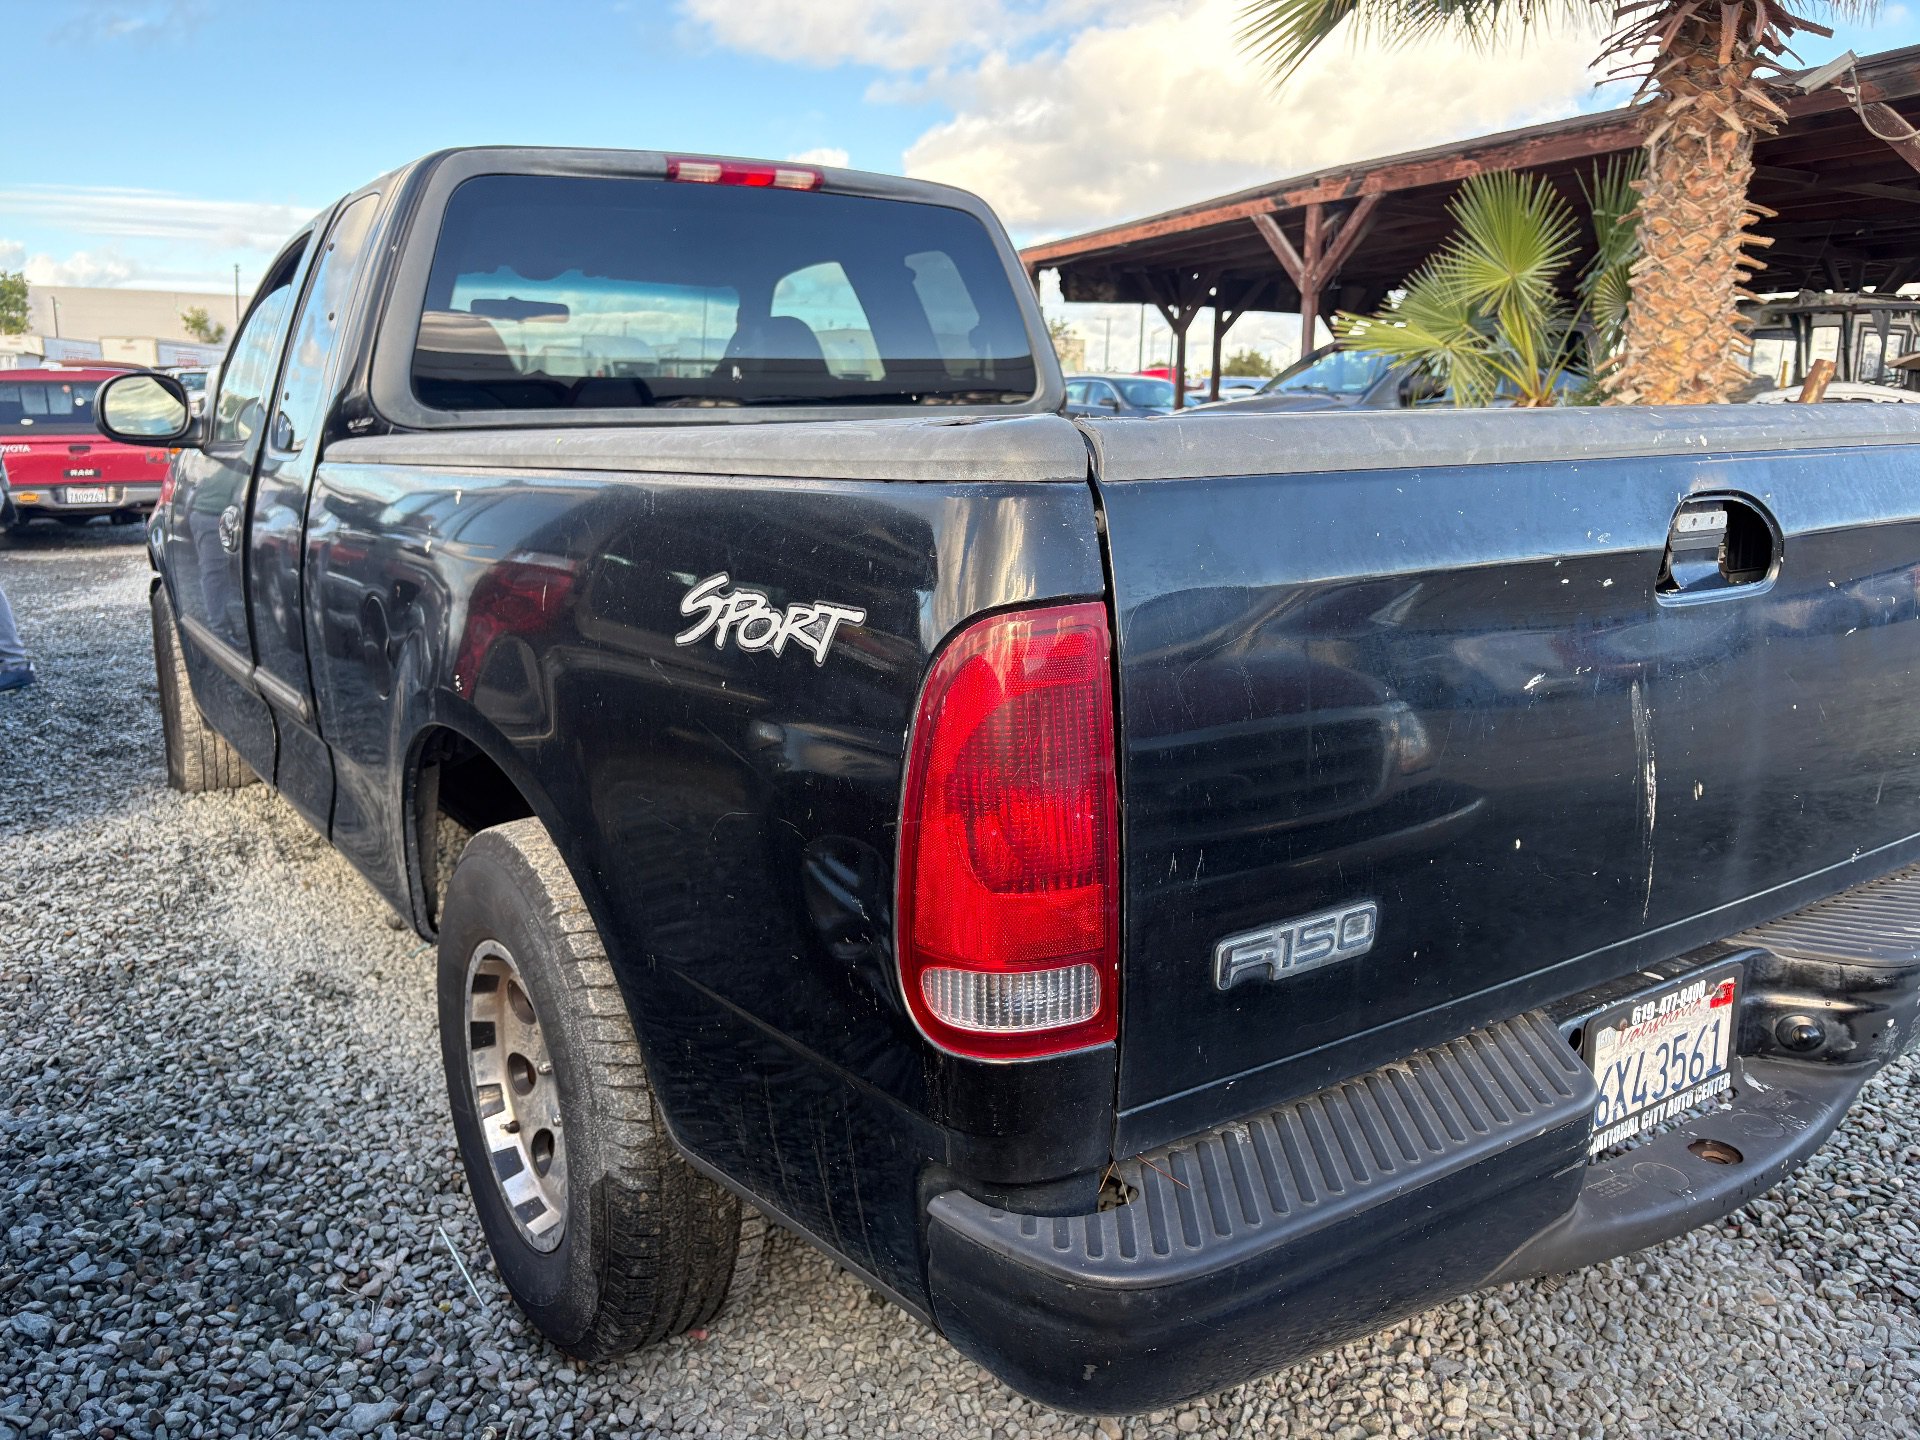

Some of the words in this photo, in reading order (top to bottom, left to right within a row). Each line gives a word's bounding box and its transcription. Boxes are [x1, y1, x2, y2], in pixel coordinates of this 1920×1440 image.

[69, 468, 95, 477] RAM
[675, 572, 867, 666] SPORT
[1631, 979, 1707, 1025] 619-477-8400
[1594, 1018, 1723, 1128] 6X43561
[1641, 1102, 1667, 1130] CITY
[1666, 1091, 1694, 1119] AUTO
[1694, 1072, 1732, 1103] CENTER
